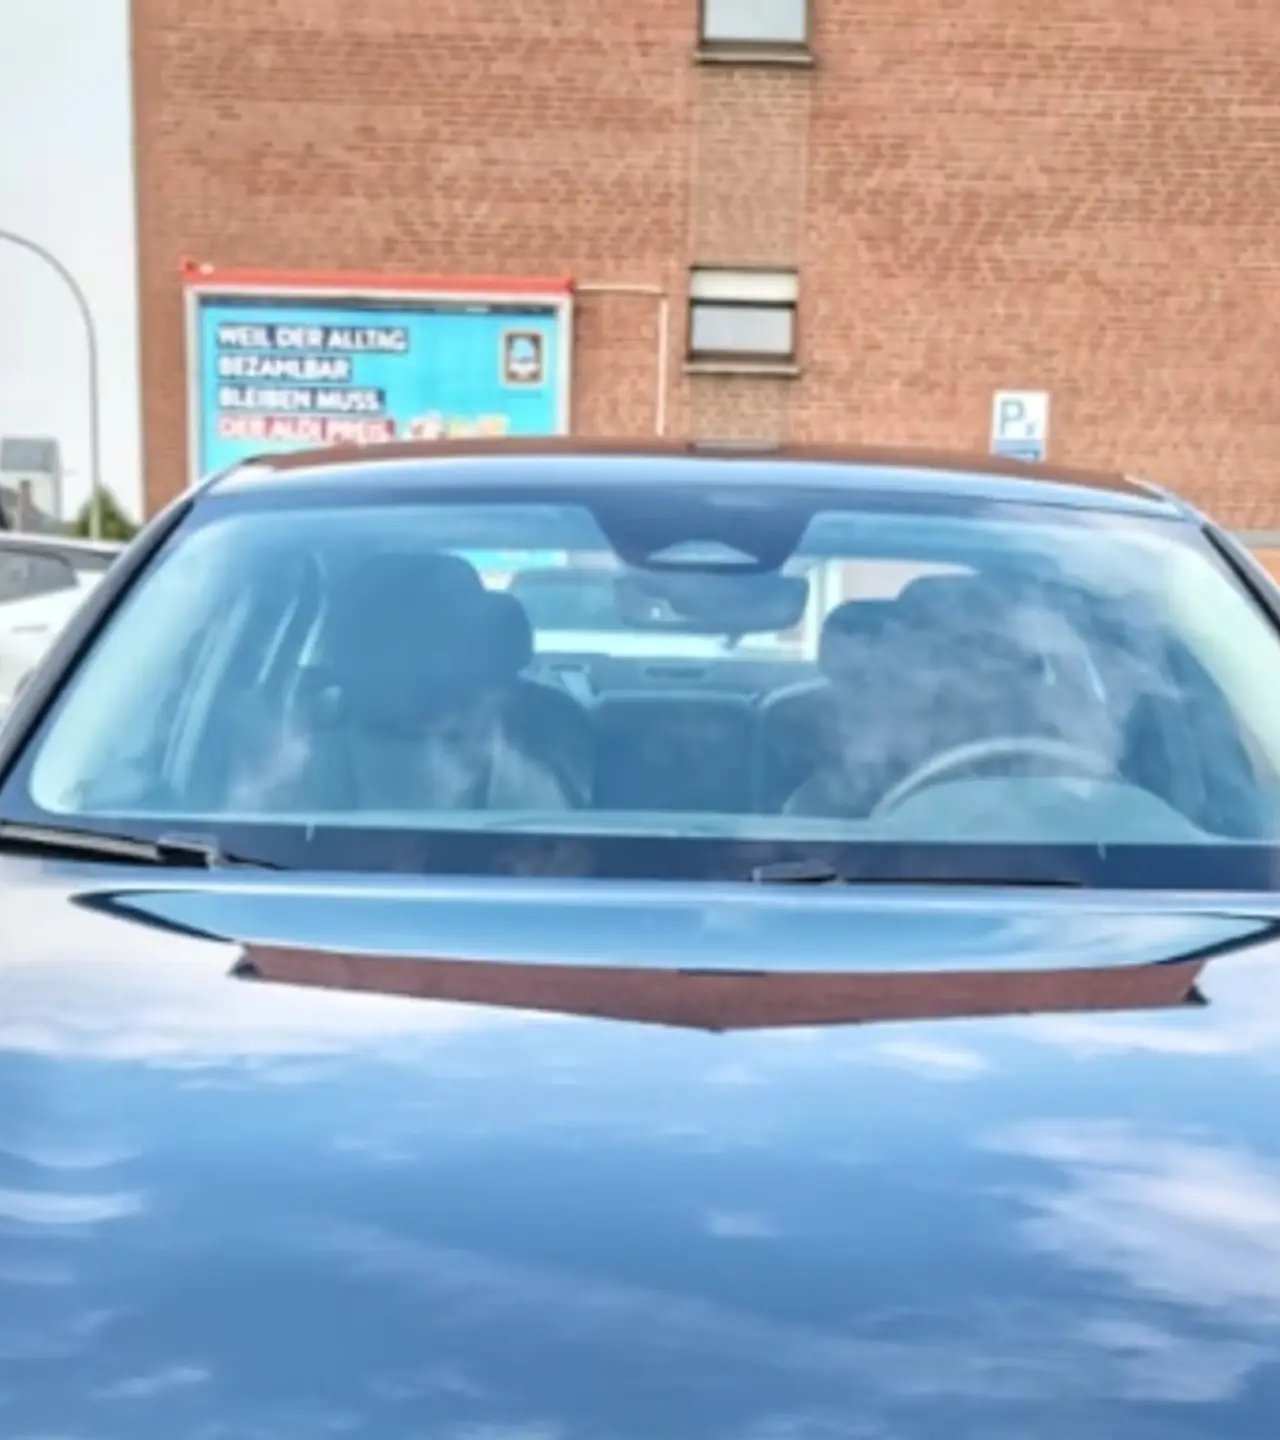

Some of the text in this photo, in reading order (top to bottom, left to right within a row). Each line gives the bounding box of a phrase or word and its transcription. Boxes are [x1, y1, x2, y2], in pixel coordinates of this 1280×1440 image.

[217, 324, 407, 350] WEIL DER ALLTAG
[218, 356, 349, 381] BEZAHLBAR
[218, 387, 311, 410] BLEIBEN
[219, 418, 265, 438] DER
[1000, 399, 1025, 435] P
